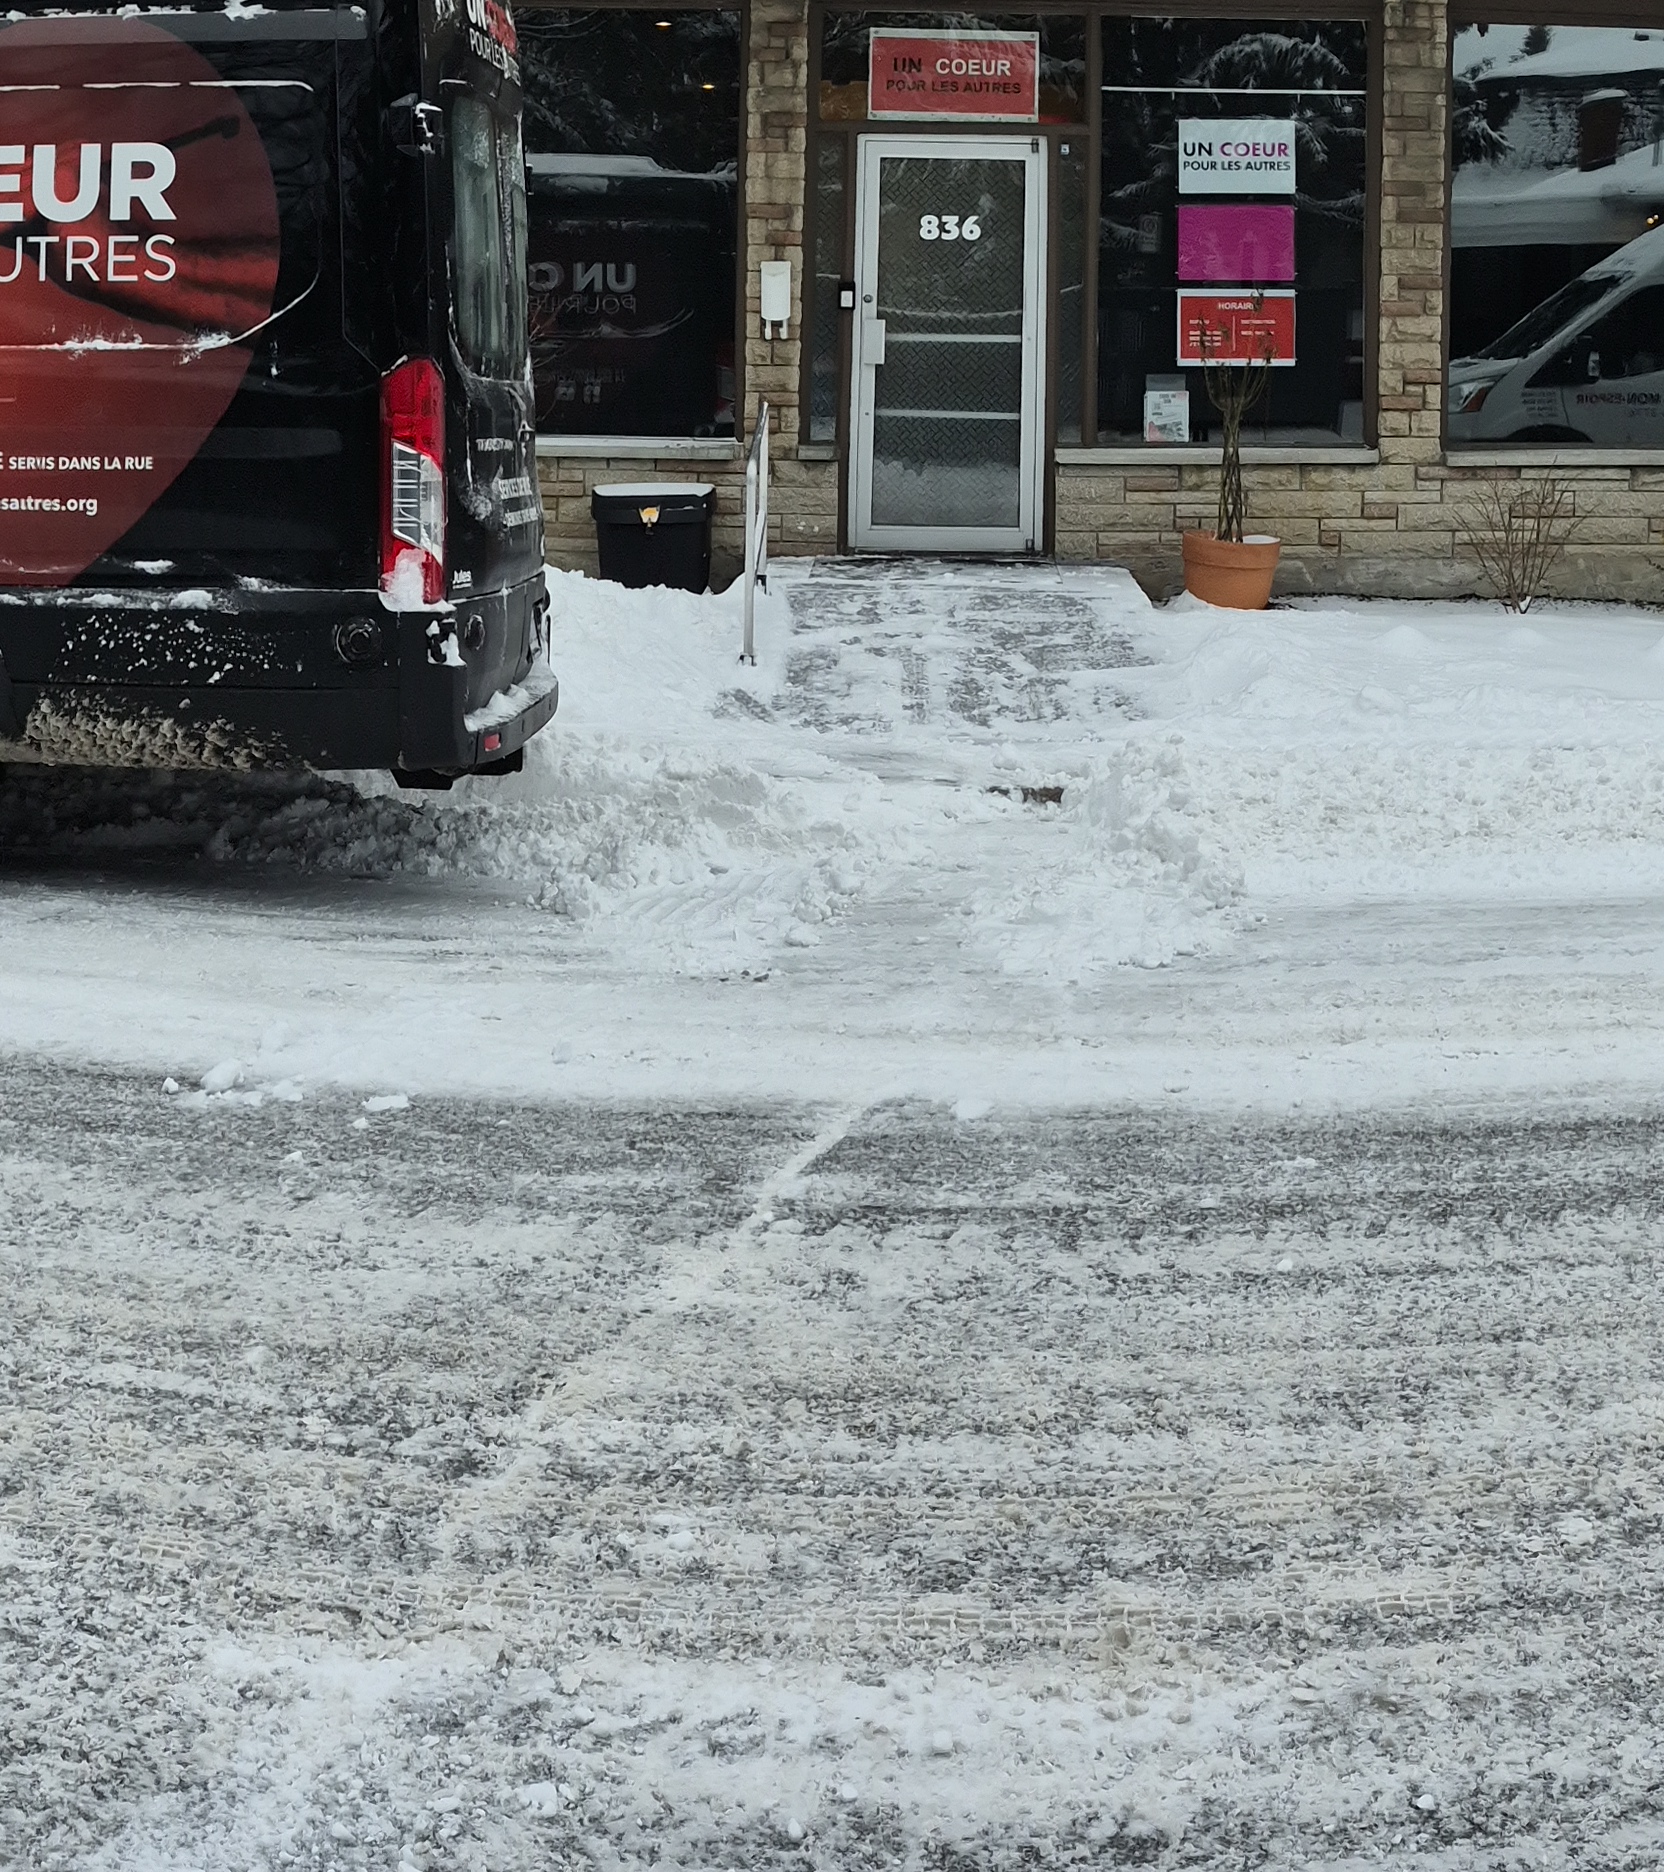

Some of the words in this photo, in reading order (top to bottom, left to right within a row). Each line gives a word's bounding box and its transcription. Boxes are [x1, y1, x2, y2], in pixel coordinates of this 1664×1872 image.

[893, 57, 922, 73] UN
[936, 58, 1012, 77] COEUR
[886, 79, 926, 92] POUR
[931, 82, 959, 93] LES
[963, 81, 1022, 95] AUTRES
[1183, 142, 1213, 157] UN
[1220, 142, 1290, 157] COEUR
[1183, 160, 1218, 171] POUR
[1221, 160, 1243, 171] LES
[1245, 161, 1291, 171] AUTRES
[919, 214, 982, 241] 836
[1218, 302, 1257, 310] HORAIR
[58, 457, 101, 470] DANS
[104, 457, 122, 470] LA
[125, 457, 154, 470] RUE
